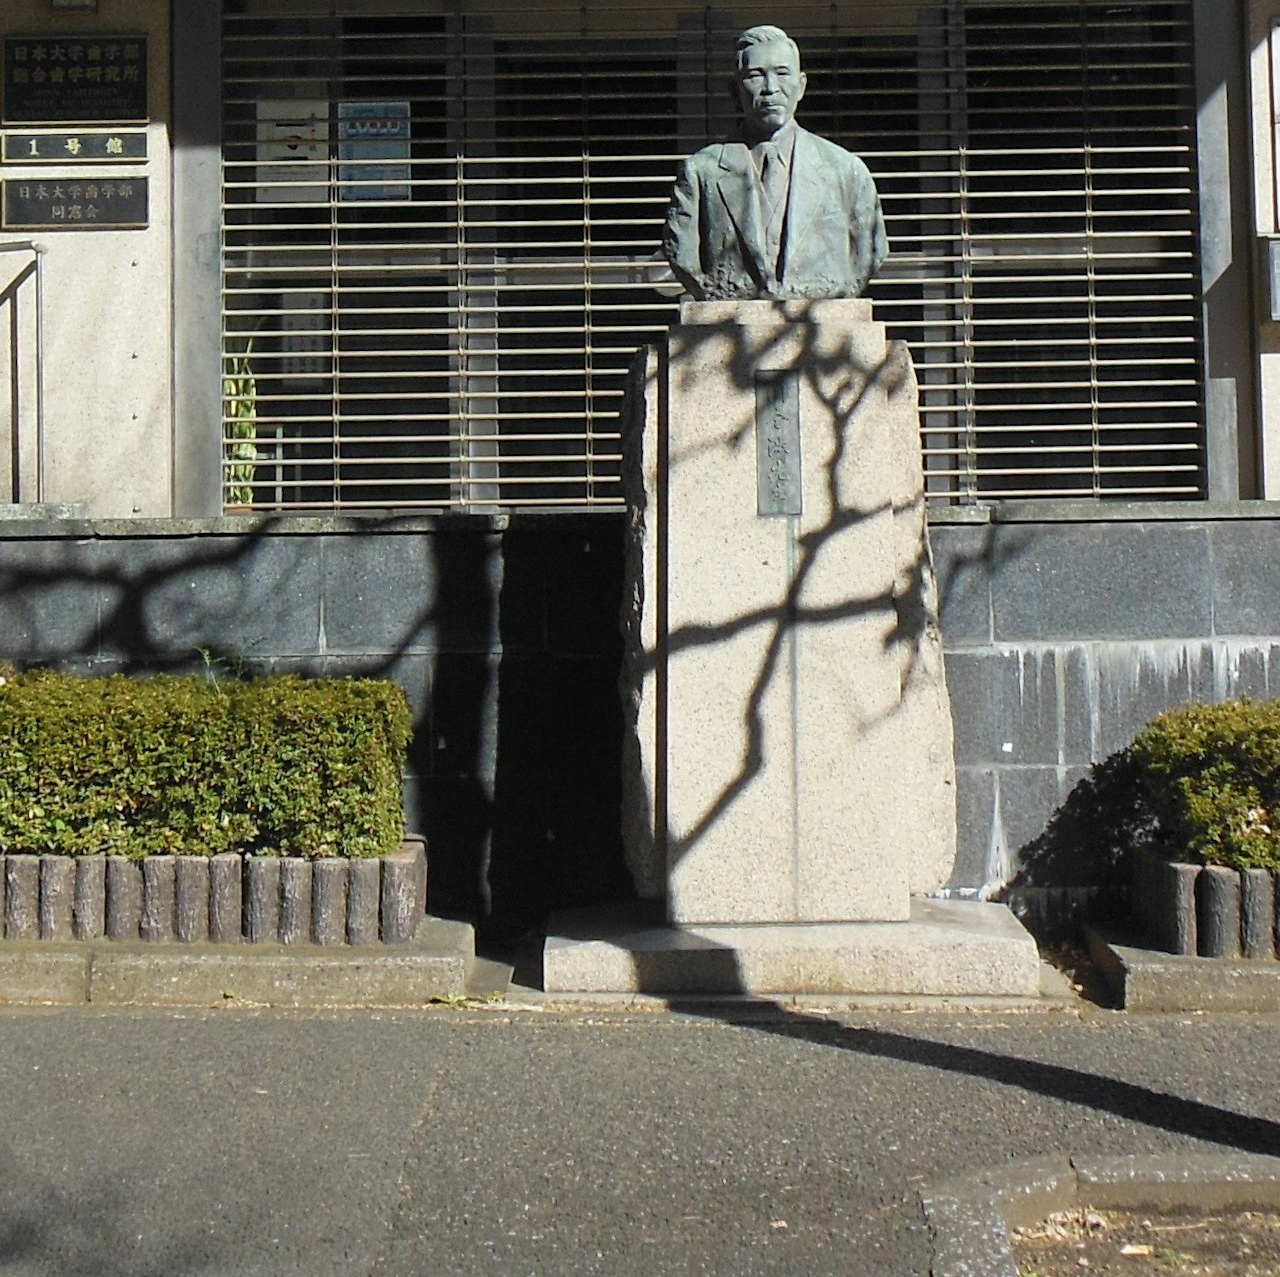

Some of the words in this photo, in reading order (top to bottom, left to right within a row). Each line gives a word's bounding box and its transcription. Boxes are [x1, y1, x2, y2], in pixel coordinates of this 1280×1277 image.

[19, 185, 133, 200] 日本大学歯学部
[52, 205, 99, 219] 同窓会
